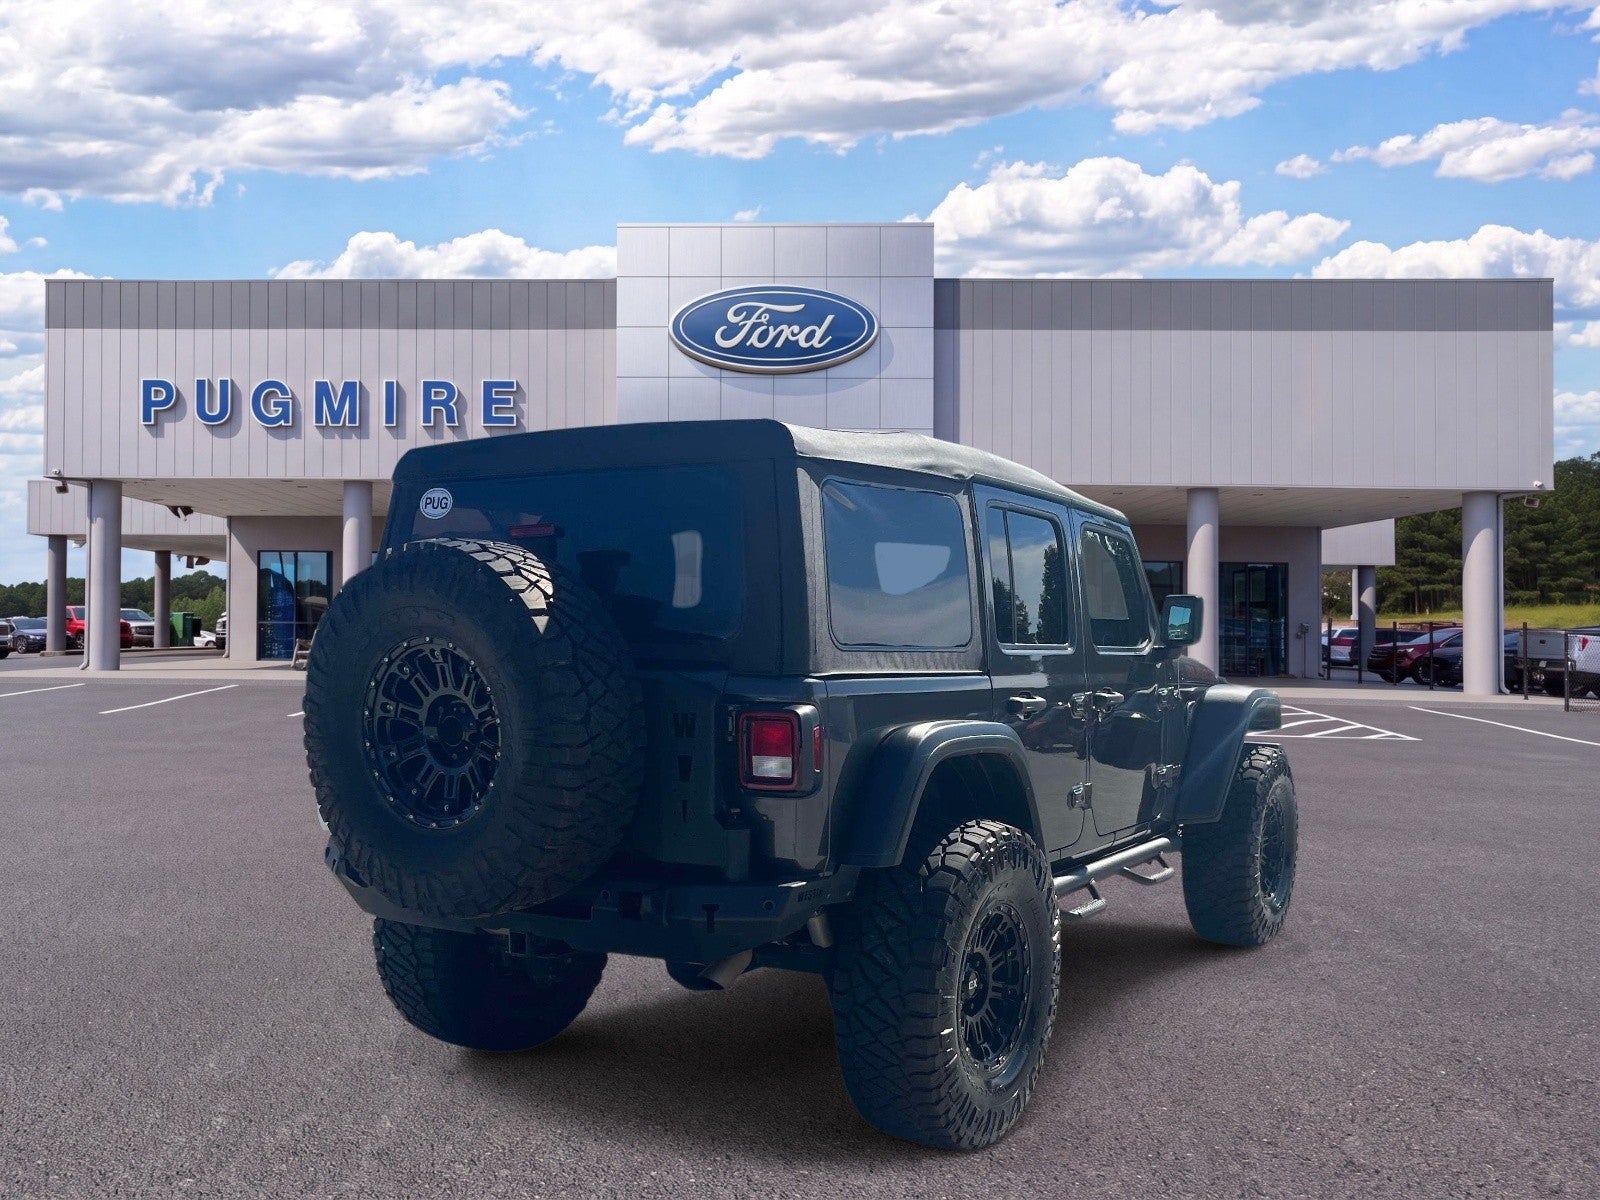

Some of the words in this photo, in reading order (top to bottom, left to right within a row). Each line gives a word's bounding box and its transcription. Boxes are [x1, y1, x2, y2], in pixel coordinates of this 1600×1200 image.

[715, 302, 834, 348] Ford
[141, 377, 518, 428] PUGMIRE
[425, 497, 448, 509] PUG
